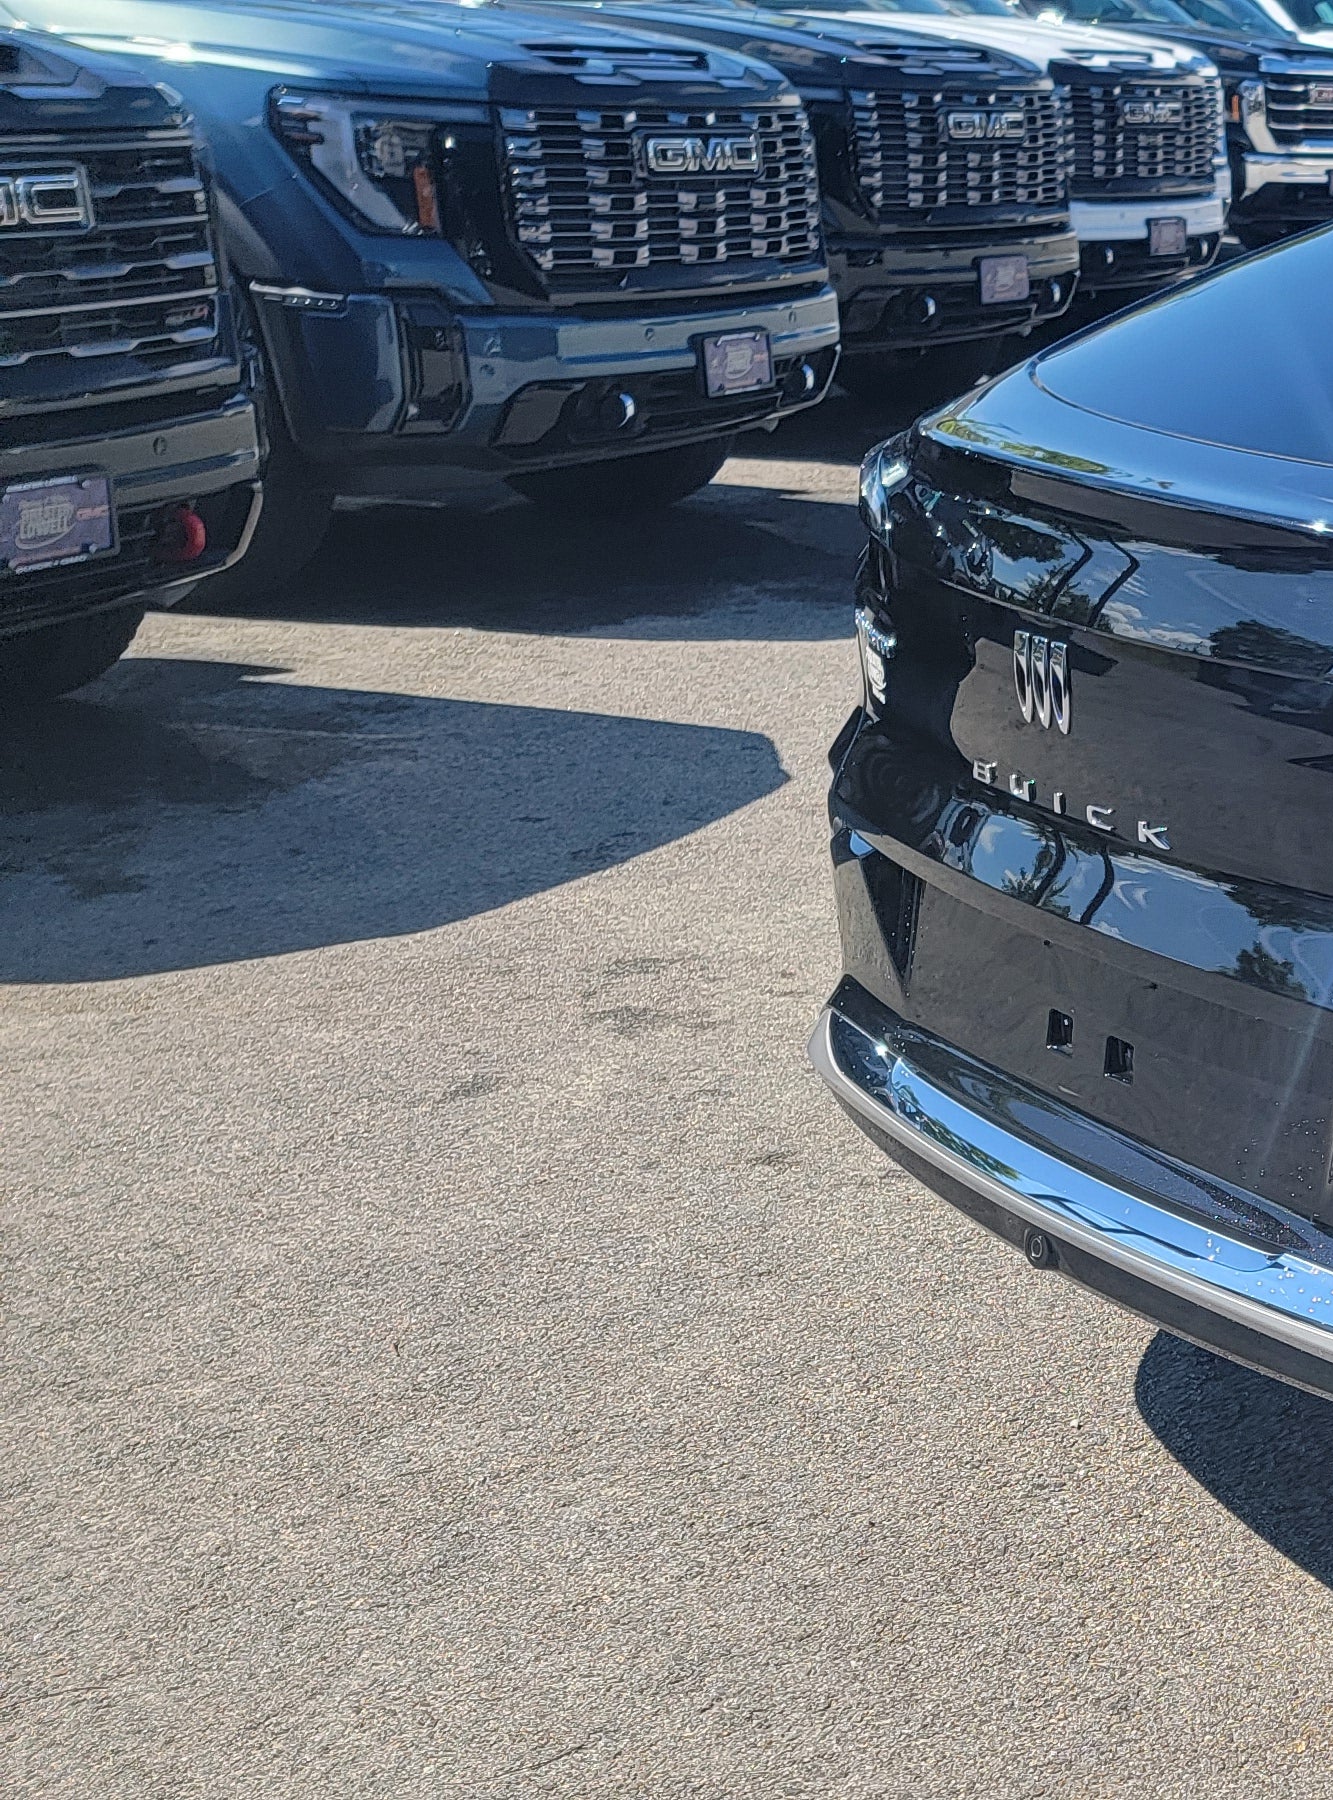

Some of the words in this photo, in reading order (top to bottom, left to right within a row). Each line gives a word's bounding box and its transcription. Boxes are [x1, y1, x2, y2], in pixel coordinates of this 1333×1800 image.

[948, 111, 1025, 138] GMC
[1124, 101, 1183, 124] GMC
[647, 137, 757, 172] GMC
[973, 759, 1173, 850] BUICK
